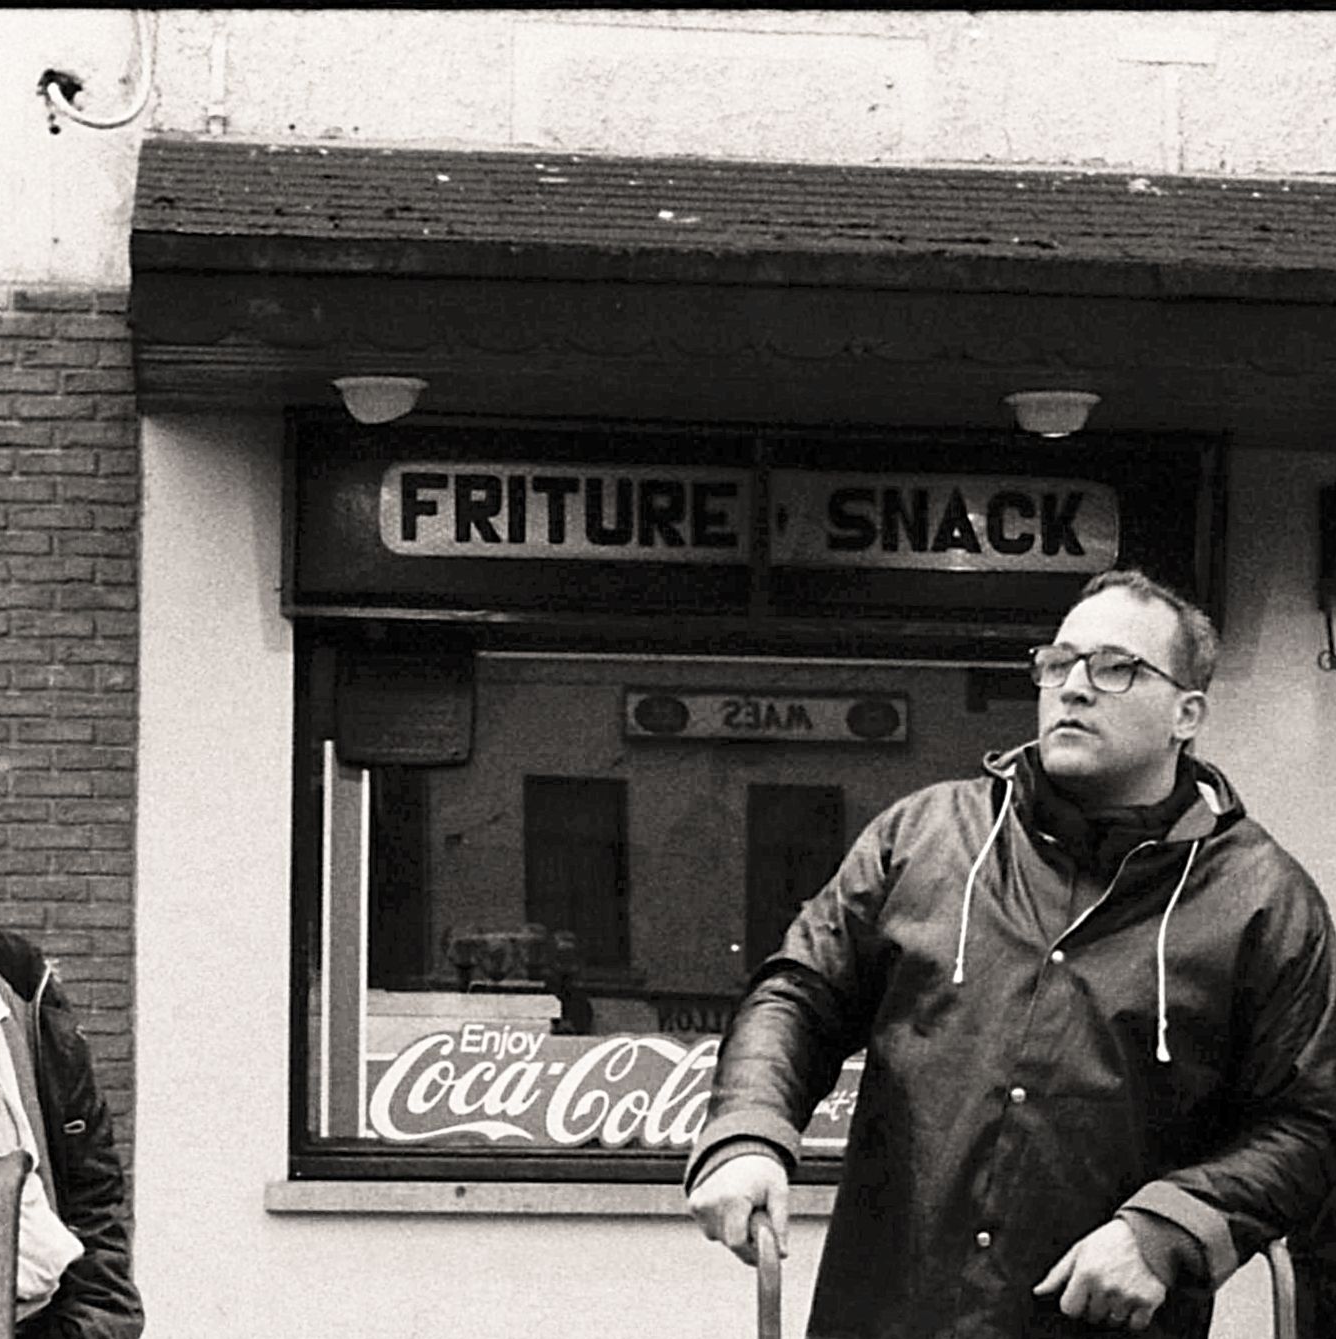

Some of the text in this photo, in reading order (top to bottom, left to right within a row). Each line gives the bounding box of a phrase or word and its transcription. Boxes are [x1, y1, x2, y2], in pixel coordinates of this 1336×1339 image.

[401, 471, 1086, 557] FRITURE SNACK
[460, 1023, 546, 1062] Enjoy
